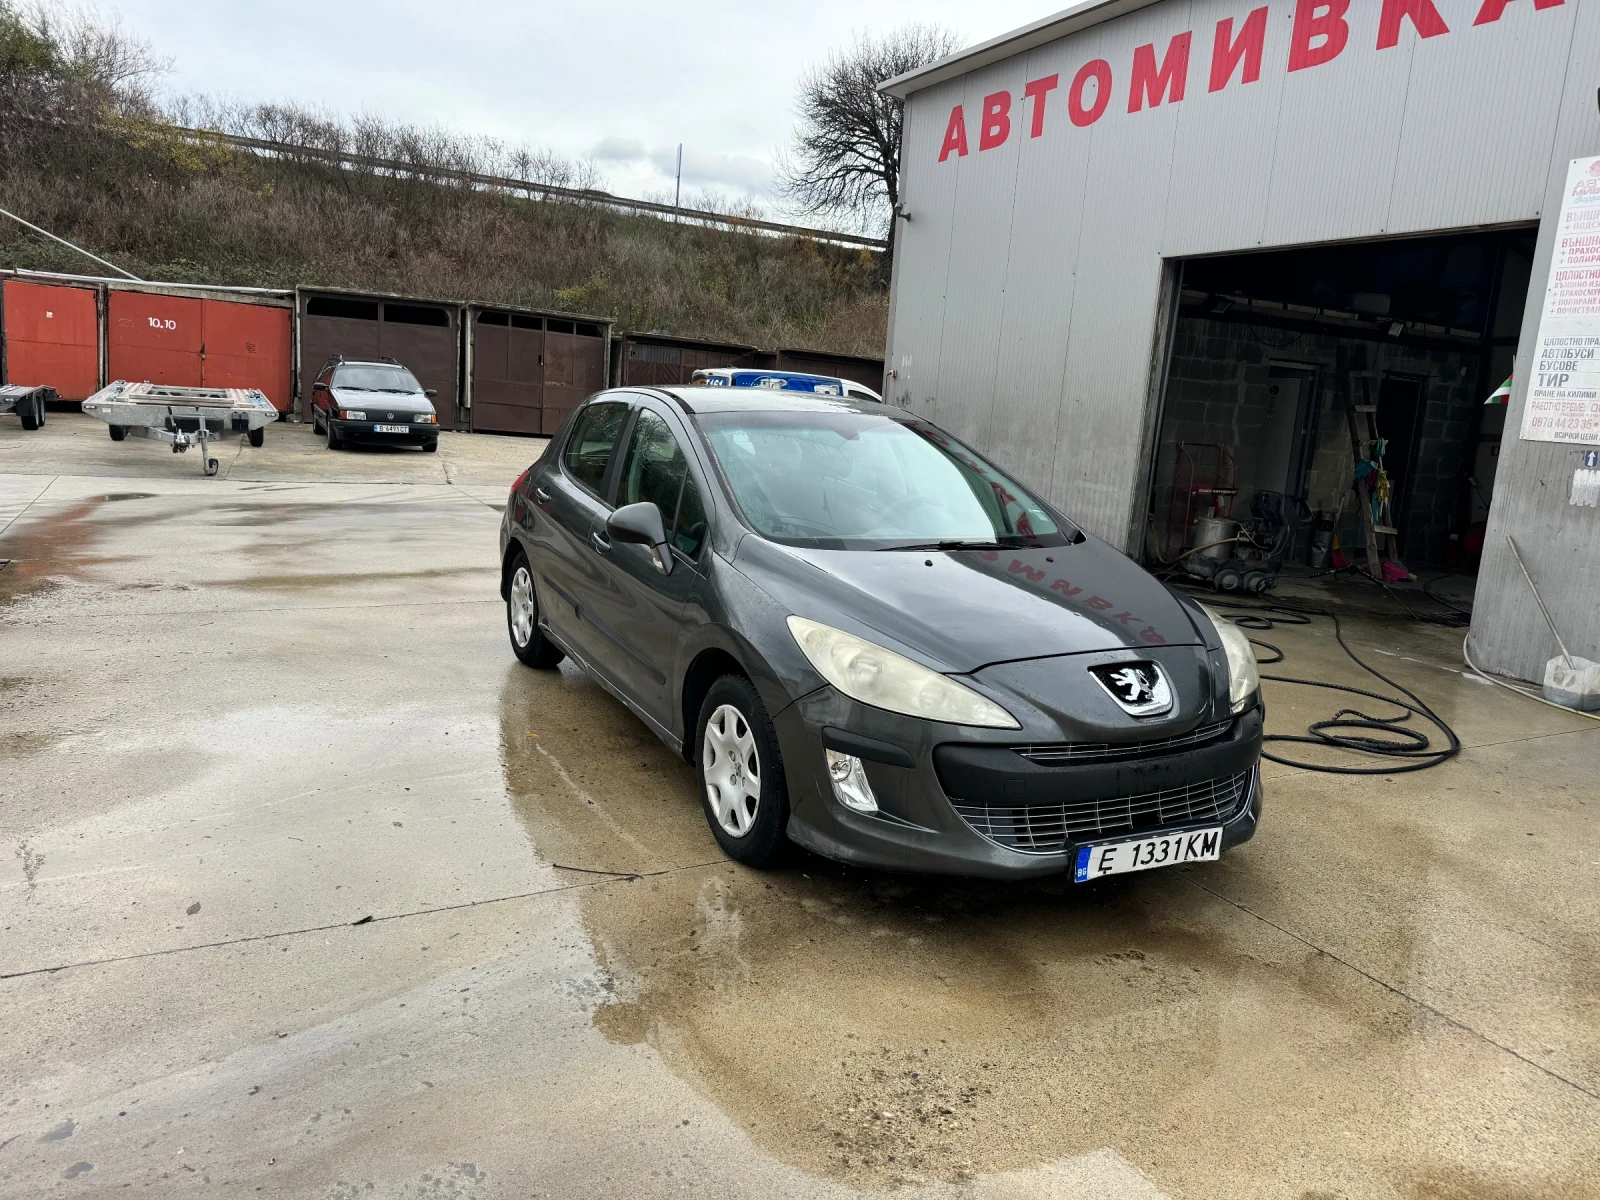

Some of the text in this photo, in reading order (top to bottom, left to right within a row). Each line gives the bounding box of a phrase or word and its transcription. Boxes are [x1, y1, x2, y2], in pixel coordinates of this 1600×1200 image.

[1558, 297, 1598, 306] ПОЛИРАНЕ
[147, 316, 177, 330] 10.10
[1543, 338, 1583, 347] ЦЯЛОСТНО
[1541, 348, 1595, 359] АВТОБУСИ
[1539, 360, 1579, 371] БУСОВЕ
[1538, 373, 1569, 387] ТИР
[1533, 389, 1597, 399] ПРАНЕ НА КИЛИМИ
[1531, 401, 1561, 411] РАБОТНО
[1554, 417, 1566, 429] 44
[1567, 418, 1580, 429] 23
[1580, 418, 1593, 430] 35
[1554, 431, 1599, 441] ВСИЧКИ ЦЕНИ
[1098, 831, 1219, 874] E 1331KM
[1077, 868, 1087, 877] BG
